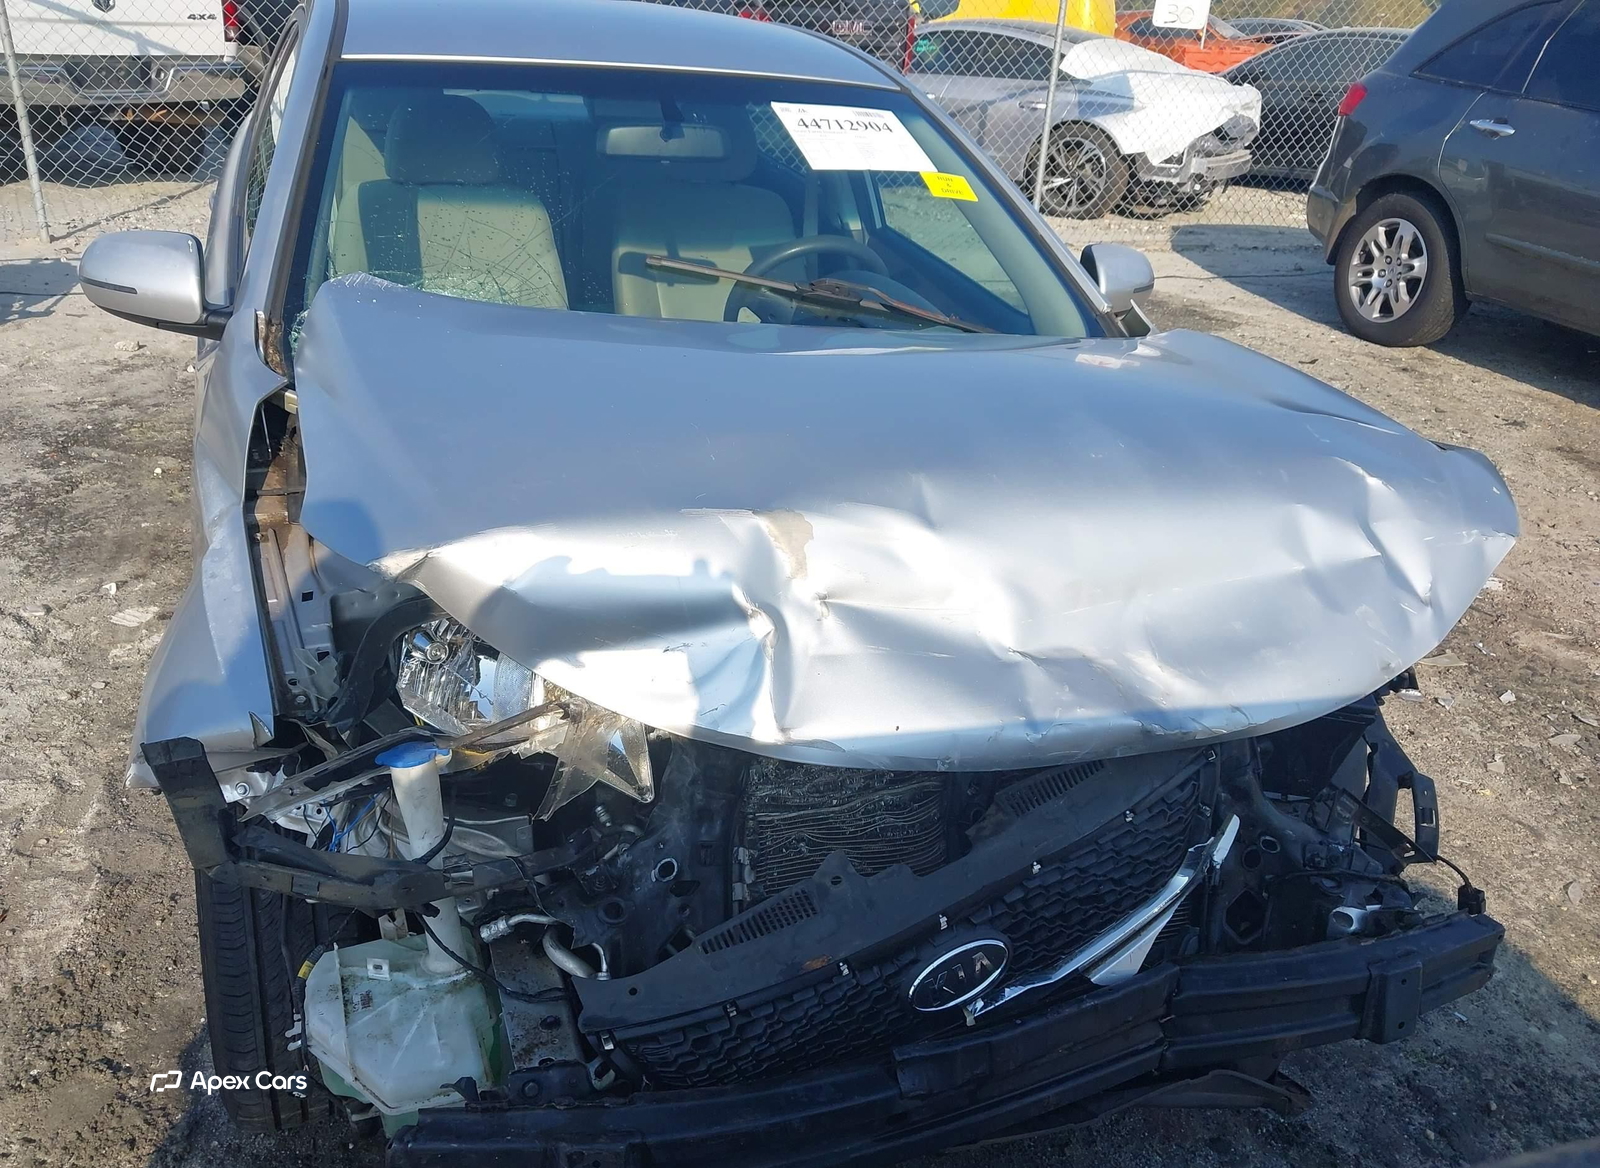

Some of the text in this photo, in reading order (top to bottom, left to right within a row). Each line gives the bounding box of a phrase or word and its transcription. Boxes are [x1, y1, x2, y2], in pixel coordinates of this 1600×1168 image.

[1164, 4, 1194, 24] 30
[797, 117, 894, 133] 44712904
[924, 952, 996, 1006] KIA
